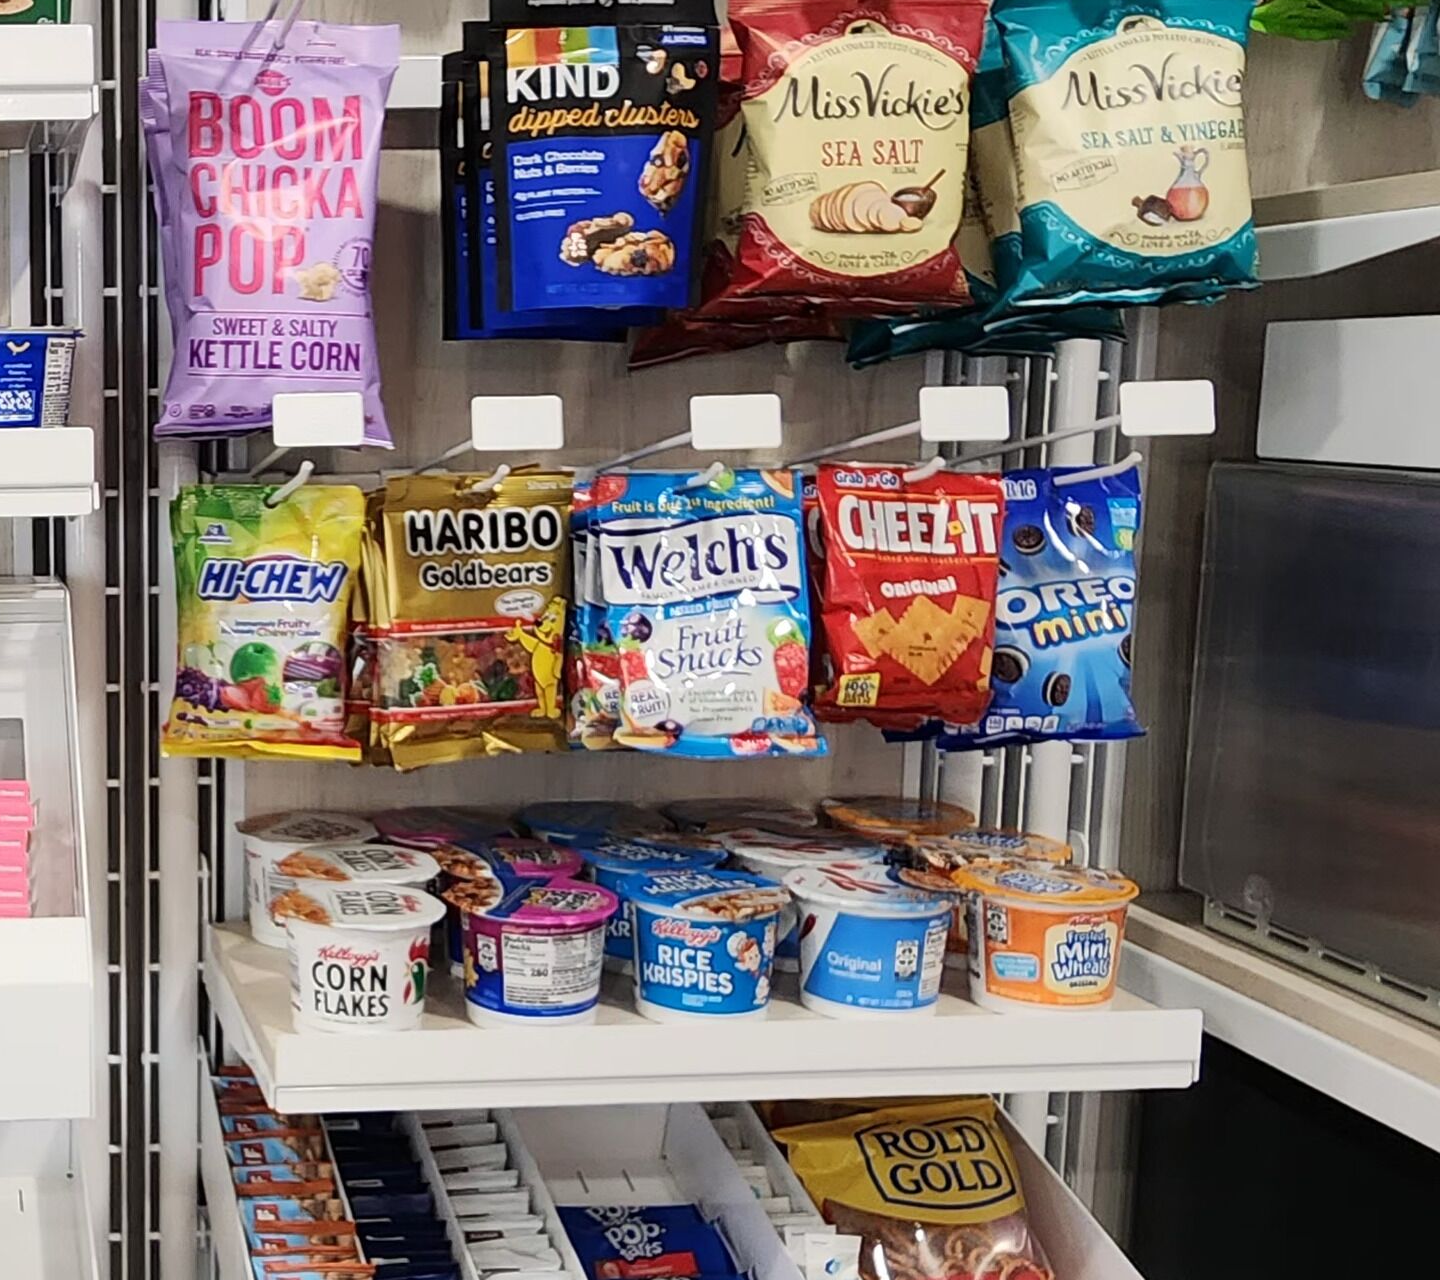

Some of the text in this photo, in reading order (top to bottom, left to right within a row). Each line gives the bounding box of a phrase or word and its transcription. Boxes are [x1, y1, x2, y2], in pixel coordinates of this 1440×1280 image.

[506, 63, 620, 104] KIND
[774, 64, 965, 131] Miss Vickie's
[188, 91, 364, 162] BOOM
[509, 100, 700, 137] dipped clusters
[822, 139, 924, 167] SEA SALT
[1081, 126, 1176, 150] SEA SALT &
[190, 162, 364, 219] CHICKA
[193, 222, 306, 297] POP
[212, 317, 338, 338] SWEET & SALTY
[189, 338, 361, 372] KETTLE CORN
[834, 470, 899, 487] Grab Go
[409, 507, 559, 554] HARIBO
[607, 527, 789, 590] Welch's
[201, 562, 343, 601] HI-CHEW
[420, 562, 550, 589] Goldbears
[996, 577, 1135, 624] OREO
[678, 618, 748, 650] Fruit
[1032, 603, 1127, 646] mini
[658, 642, 763, 679] Snacks
[631, 689, 660, 703] REAL
[318, 944, 380, 966] Kellogg's
[657, 944, 713, 971] RICE
[827, 950, 882, 972] Original
[1058, 938, 1110, 964] Mini
[312, 961, 388, 992] CORN
[643, 962, 734, 995] KRISPIES
[1051, 957, 1110, 981] Wheats
[314, 990, 391, 1017] FLAKES
[878, 1116, 987, 1157] ROLD
[888, 1159, 1004, 1195] GOLD
